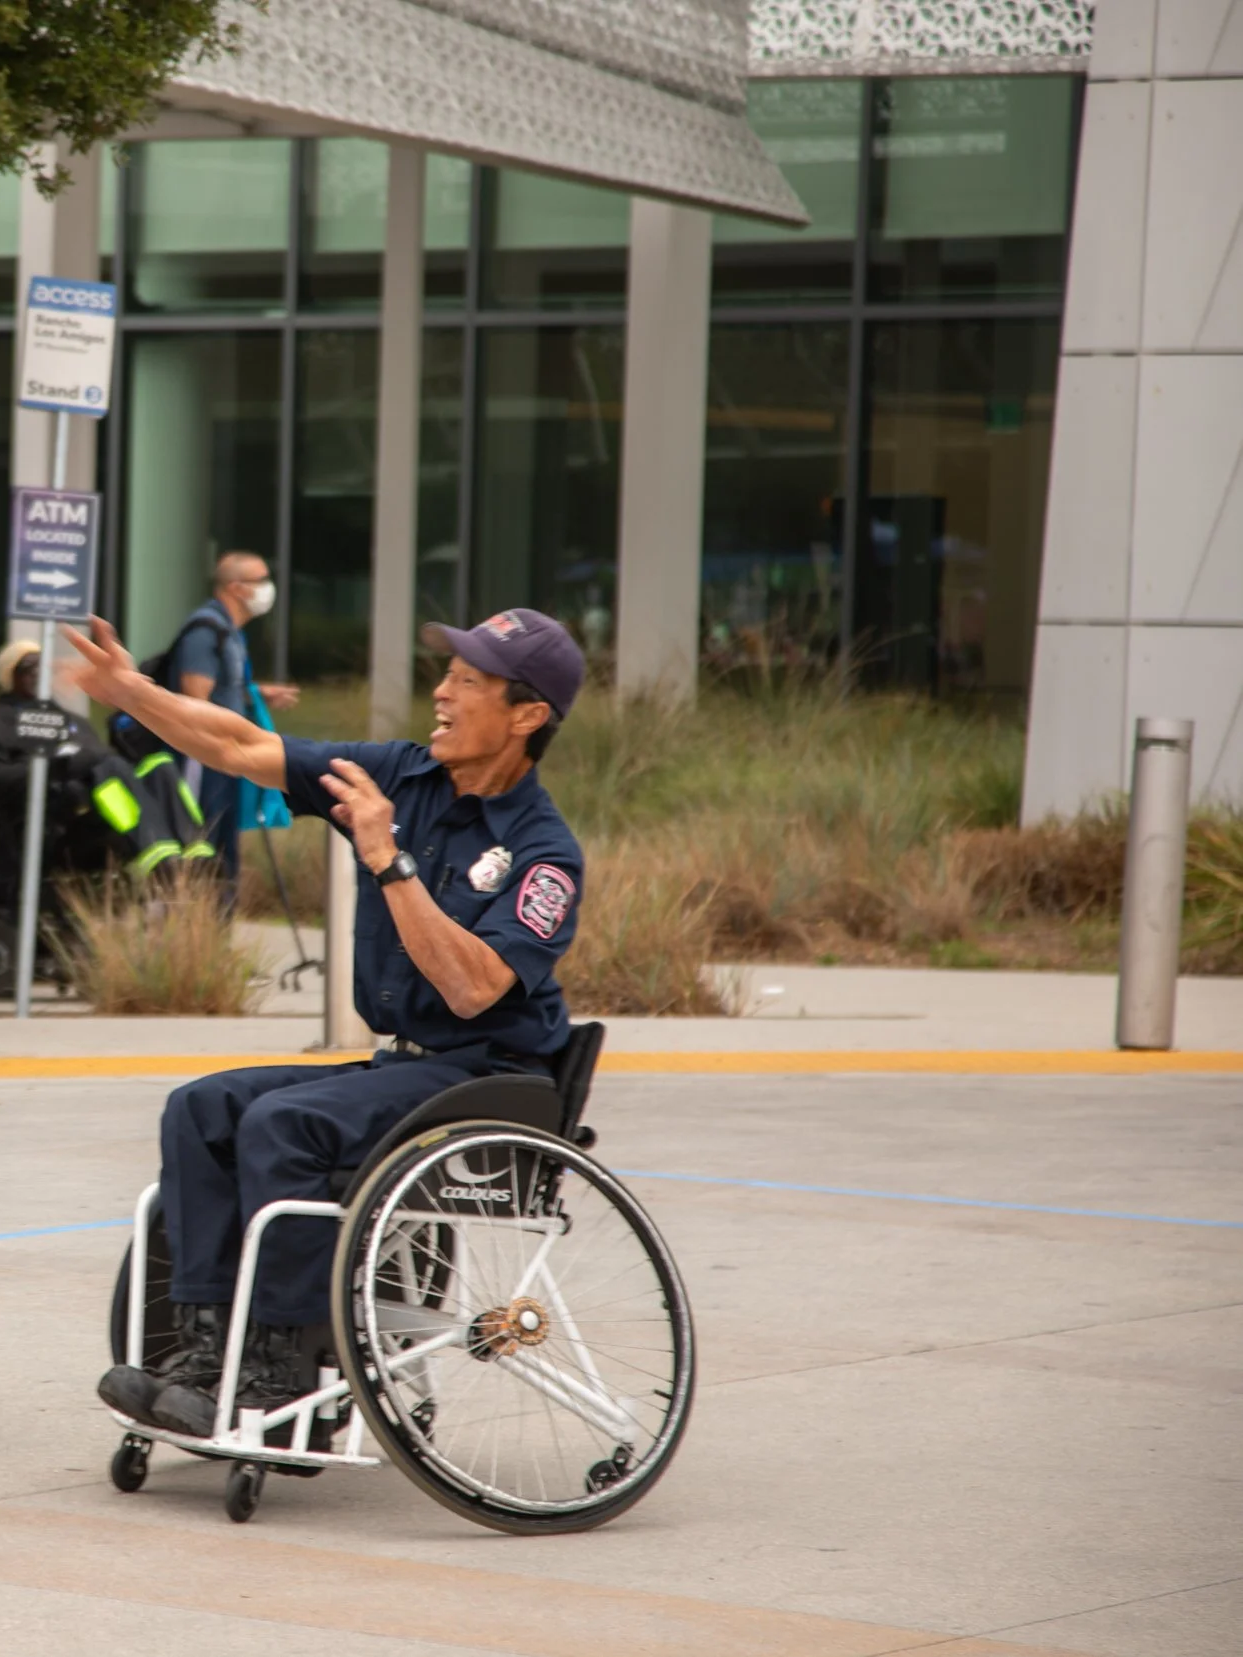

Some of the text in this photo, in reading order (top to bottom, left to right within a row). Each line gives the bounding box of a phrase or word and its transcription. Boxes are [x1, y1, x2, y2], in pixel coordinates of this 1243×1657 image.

[33, 283, 113, 310] access
[36, 313, 82, 329] Rancho
[34, 328, 106, 345] Los Amigos
[27, 379, 80, 400] Stand
[28, 500, 88, 526] ATM
[25, 529, 86, 546] LOCATED
[31, 549, 78, 565] INSIDE
[19, 712, 64, 726] ACCESS
[18, 725, 57, 739] STAND
[439, 1186, 512, 1202] COLOURS
